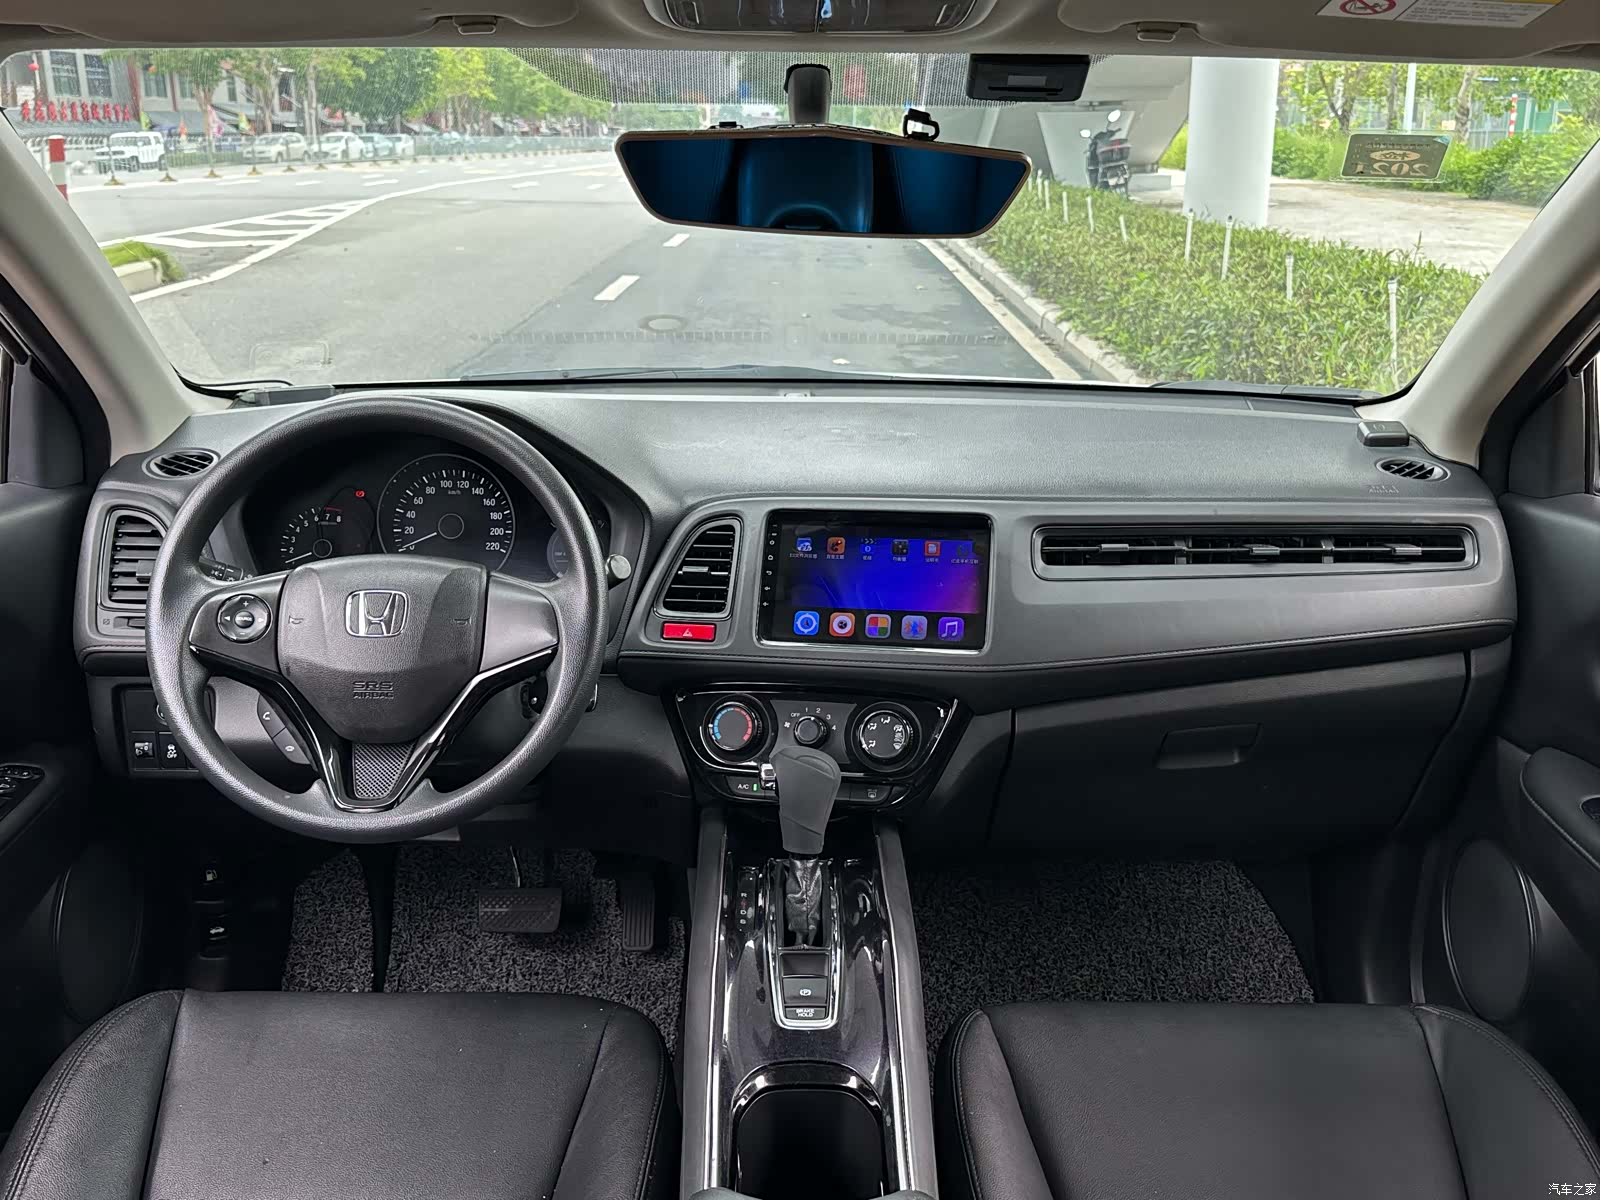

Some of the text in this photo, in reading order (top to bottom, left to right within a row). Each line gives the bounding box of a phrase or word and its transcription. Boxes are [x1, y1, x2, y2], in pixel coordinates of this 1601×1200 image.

[440, 480, 452, 489] 100
[457, 481, 469, 490] 120
[426, 486, 435, 495] 80
[472, 487, 484, 496] 140
[414, 496, 423, 505] 60
[483, 498, 495, 507] 160
[406, 510, 416, 519] 40
[490, 512, 502, 521] 180
[405, 526, 414, 535] 20
[490, 527, 504, 536] 200
[486, 542, 500, 551] 220
[352, 681, 393, 691] SRS
